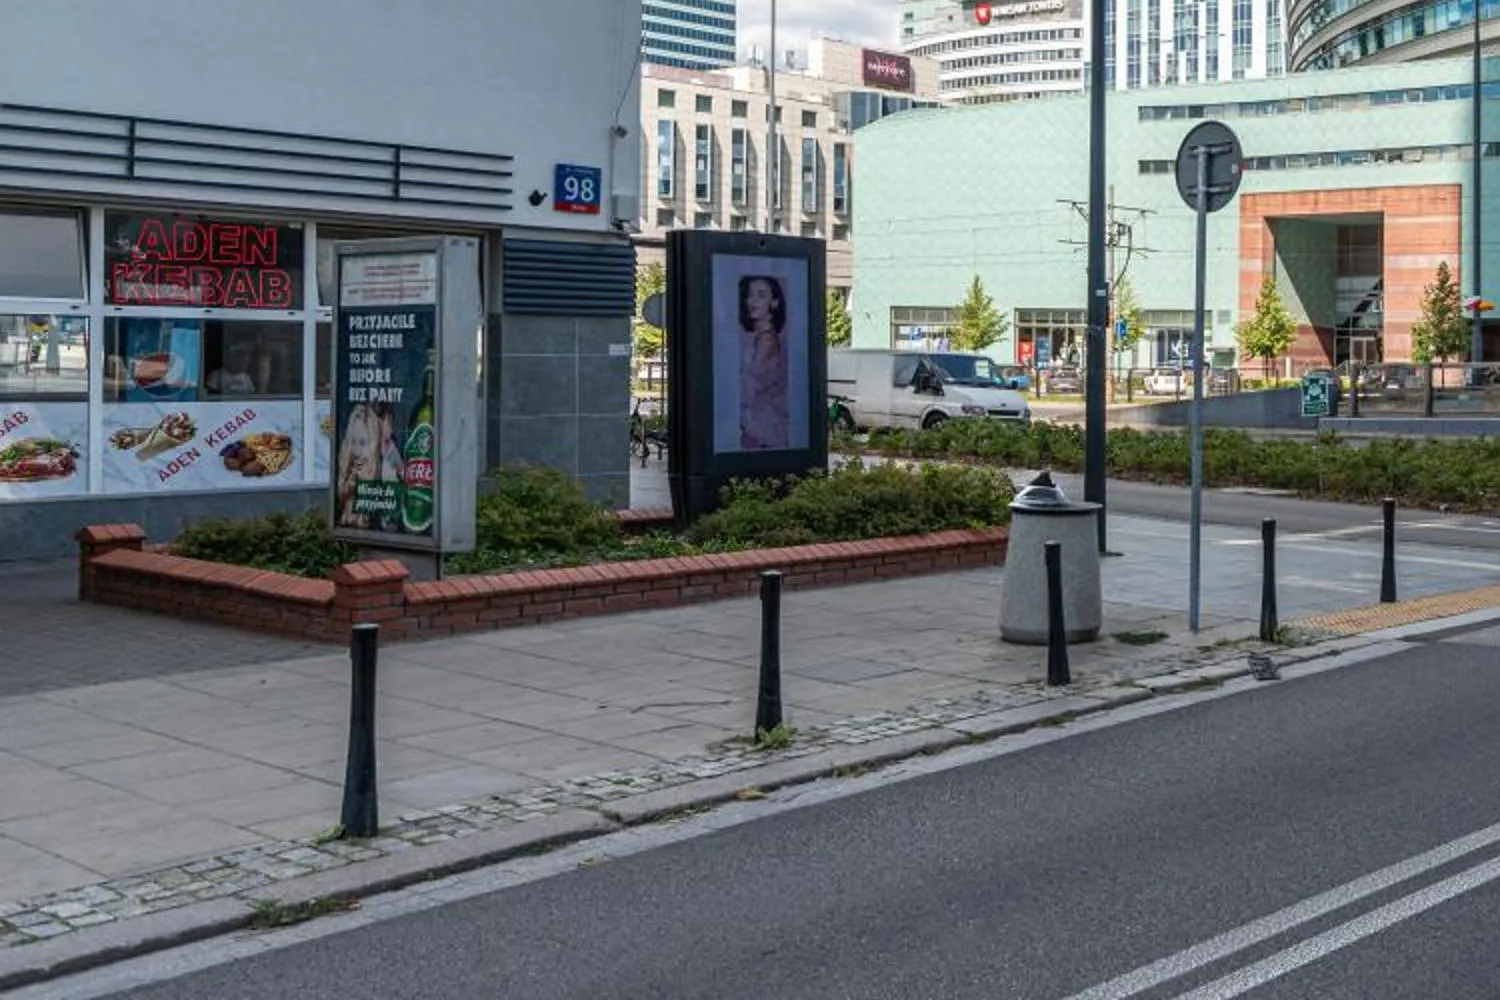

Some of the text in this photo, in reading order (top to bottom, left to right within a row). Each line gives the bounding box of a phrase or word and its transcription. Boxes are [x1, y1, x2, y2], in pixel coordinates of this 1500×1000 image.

[564, 177, 595, 202] 98
[131, 219, 278, 264] ADEN
[112, 262, 293, 308] KEBAB
[158, 407, 258, 482] ADEN KEBAB
